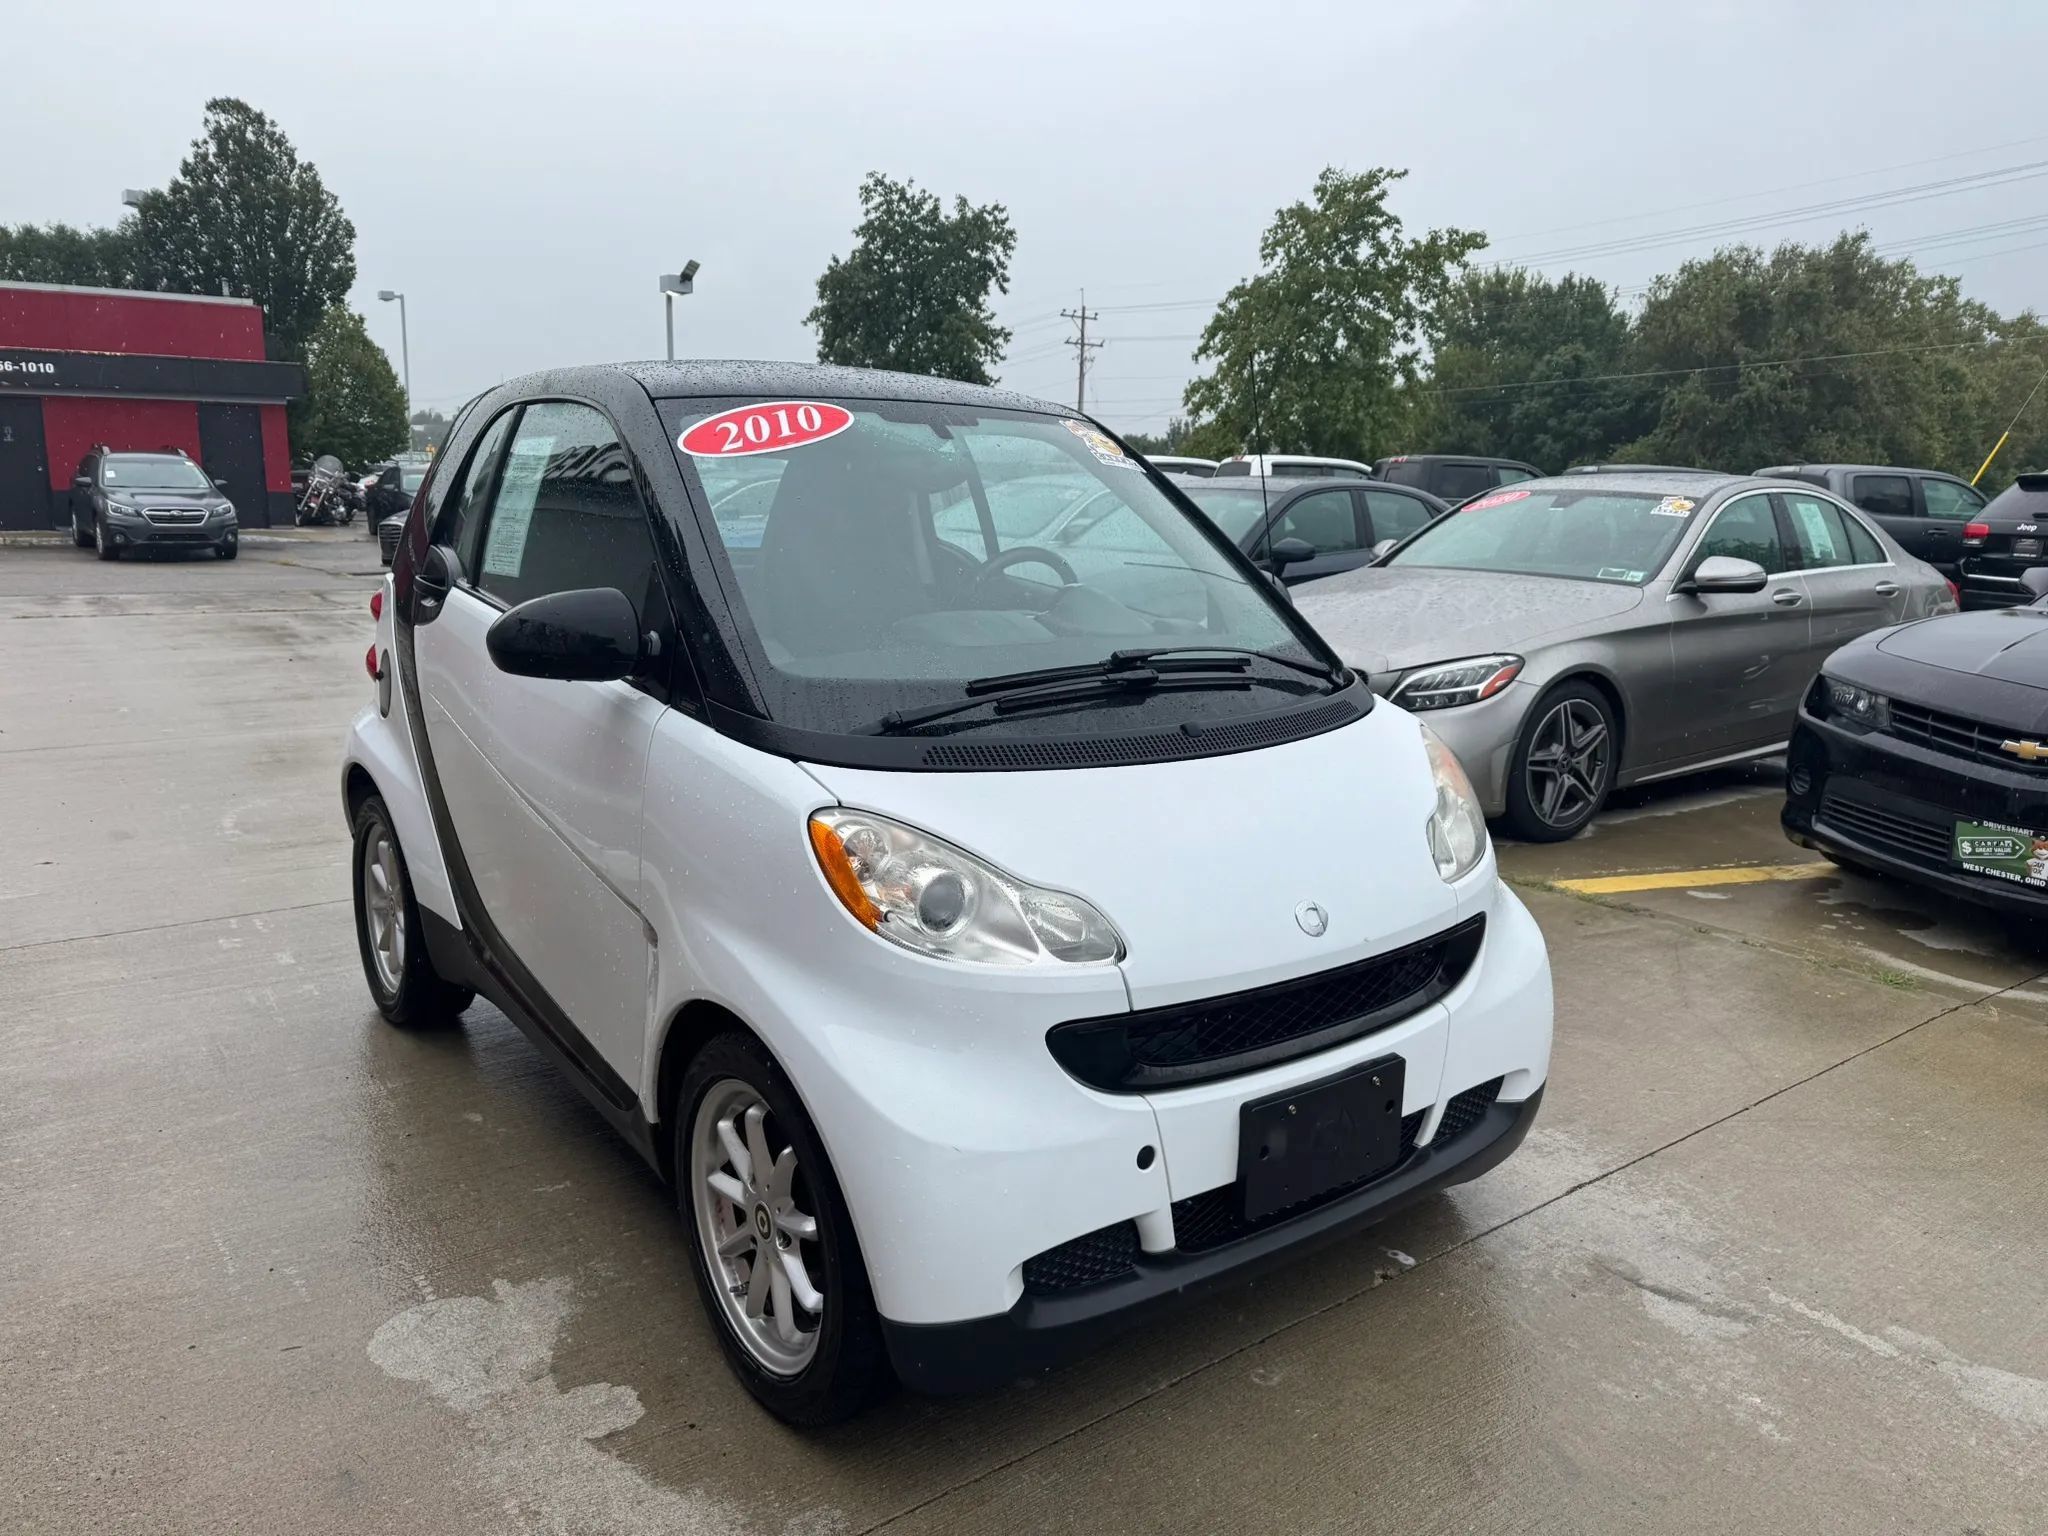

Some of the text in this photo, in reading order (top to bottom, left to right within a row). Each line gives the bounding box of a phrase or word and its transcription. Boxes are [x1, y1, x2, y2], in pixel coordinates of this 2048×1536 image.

[715, 405, 822, 453] 2010
[2016, 523, 2038, 532] Jeep
[1983, 820, 2034, 836] DRIVESMART
[1962, 862, 2046, 887] WEST CHESTER, OHIO
